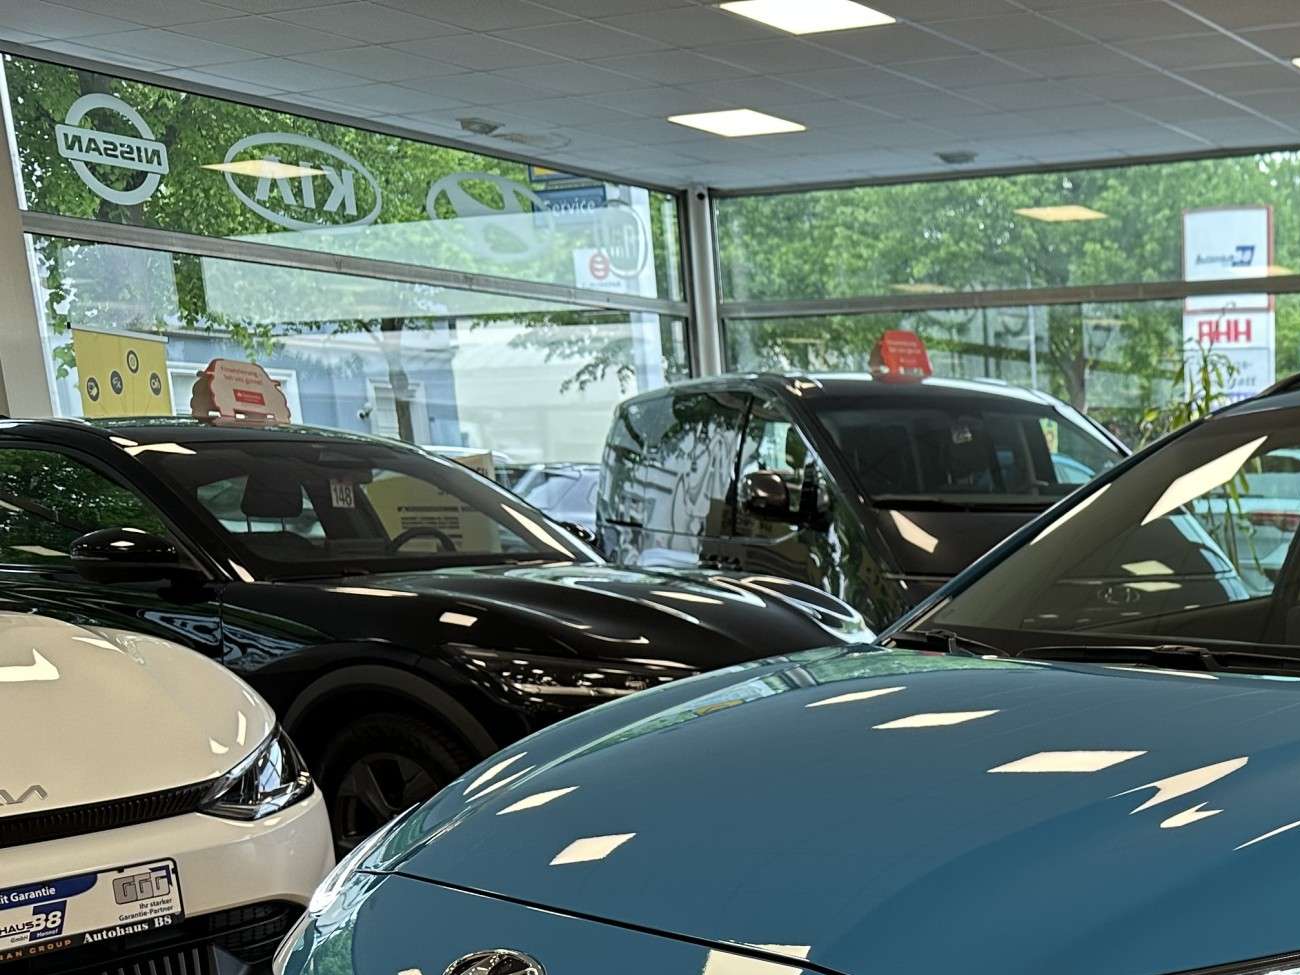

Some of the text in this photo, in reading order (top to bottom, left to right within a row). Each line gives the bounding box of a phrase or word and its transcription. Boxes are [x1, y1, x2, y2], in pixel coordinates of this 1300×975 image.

[544, 197, 596, 215] Service
[334, 486, 352, 506] 148
[10, 886, 56, 902] Garantie
[139, 898, 172, 911] Ihr starker
[118, 905, 173, 921] Garantie-Partner
[83, 914, 172, 944] Autohaus B8
[29, 939, 72, 954] GROUP
